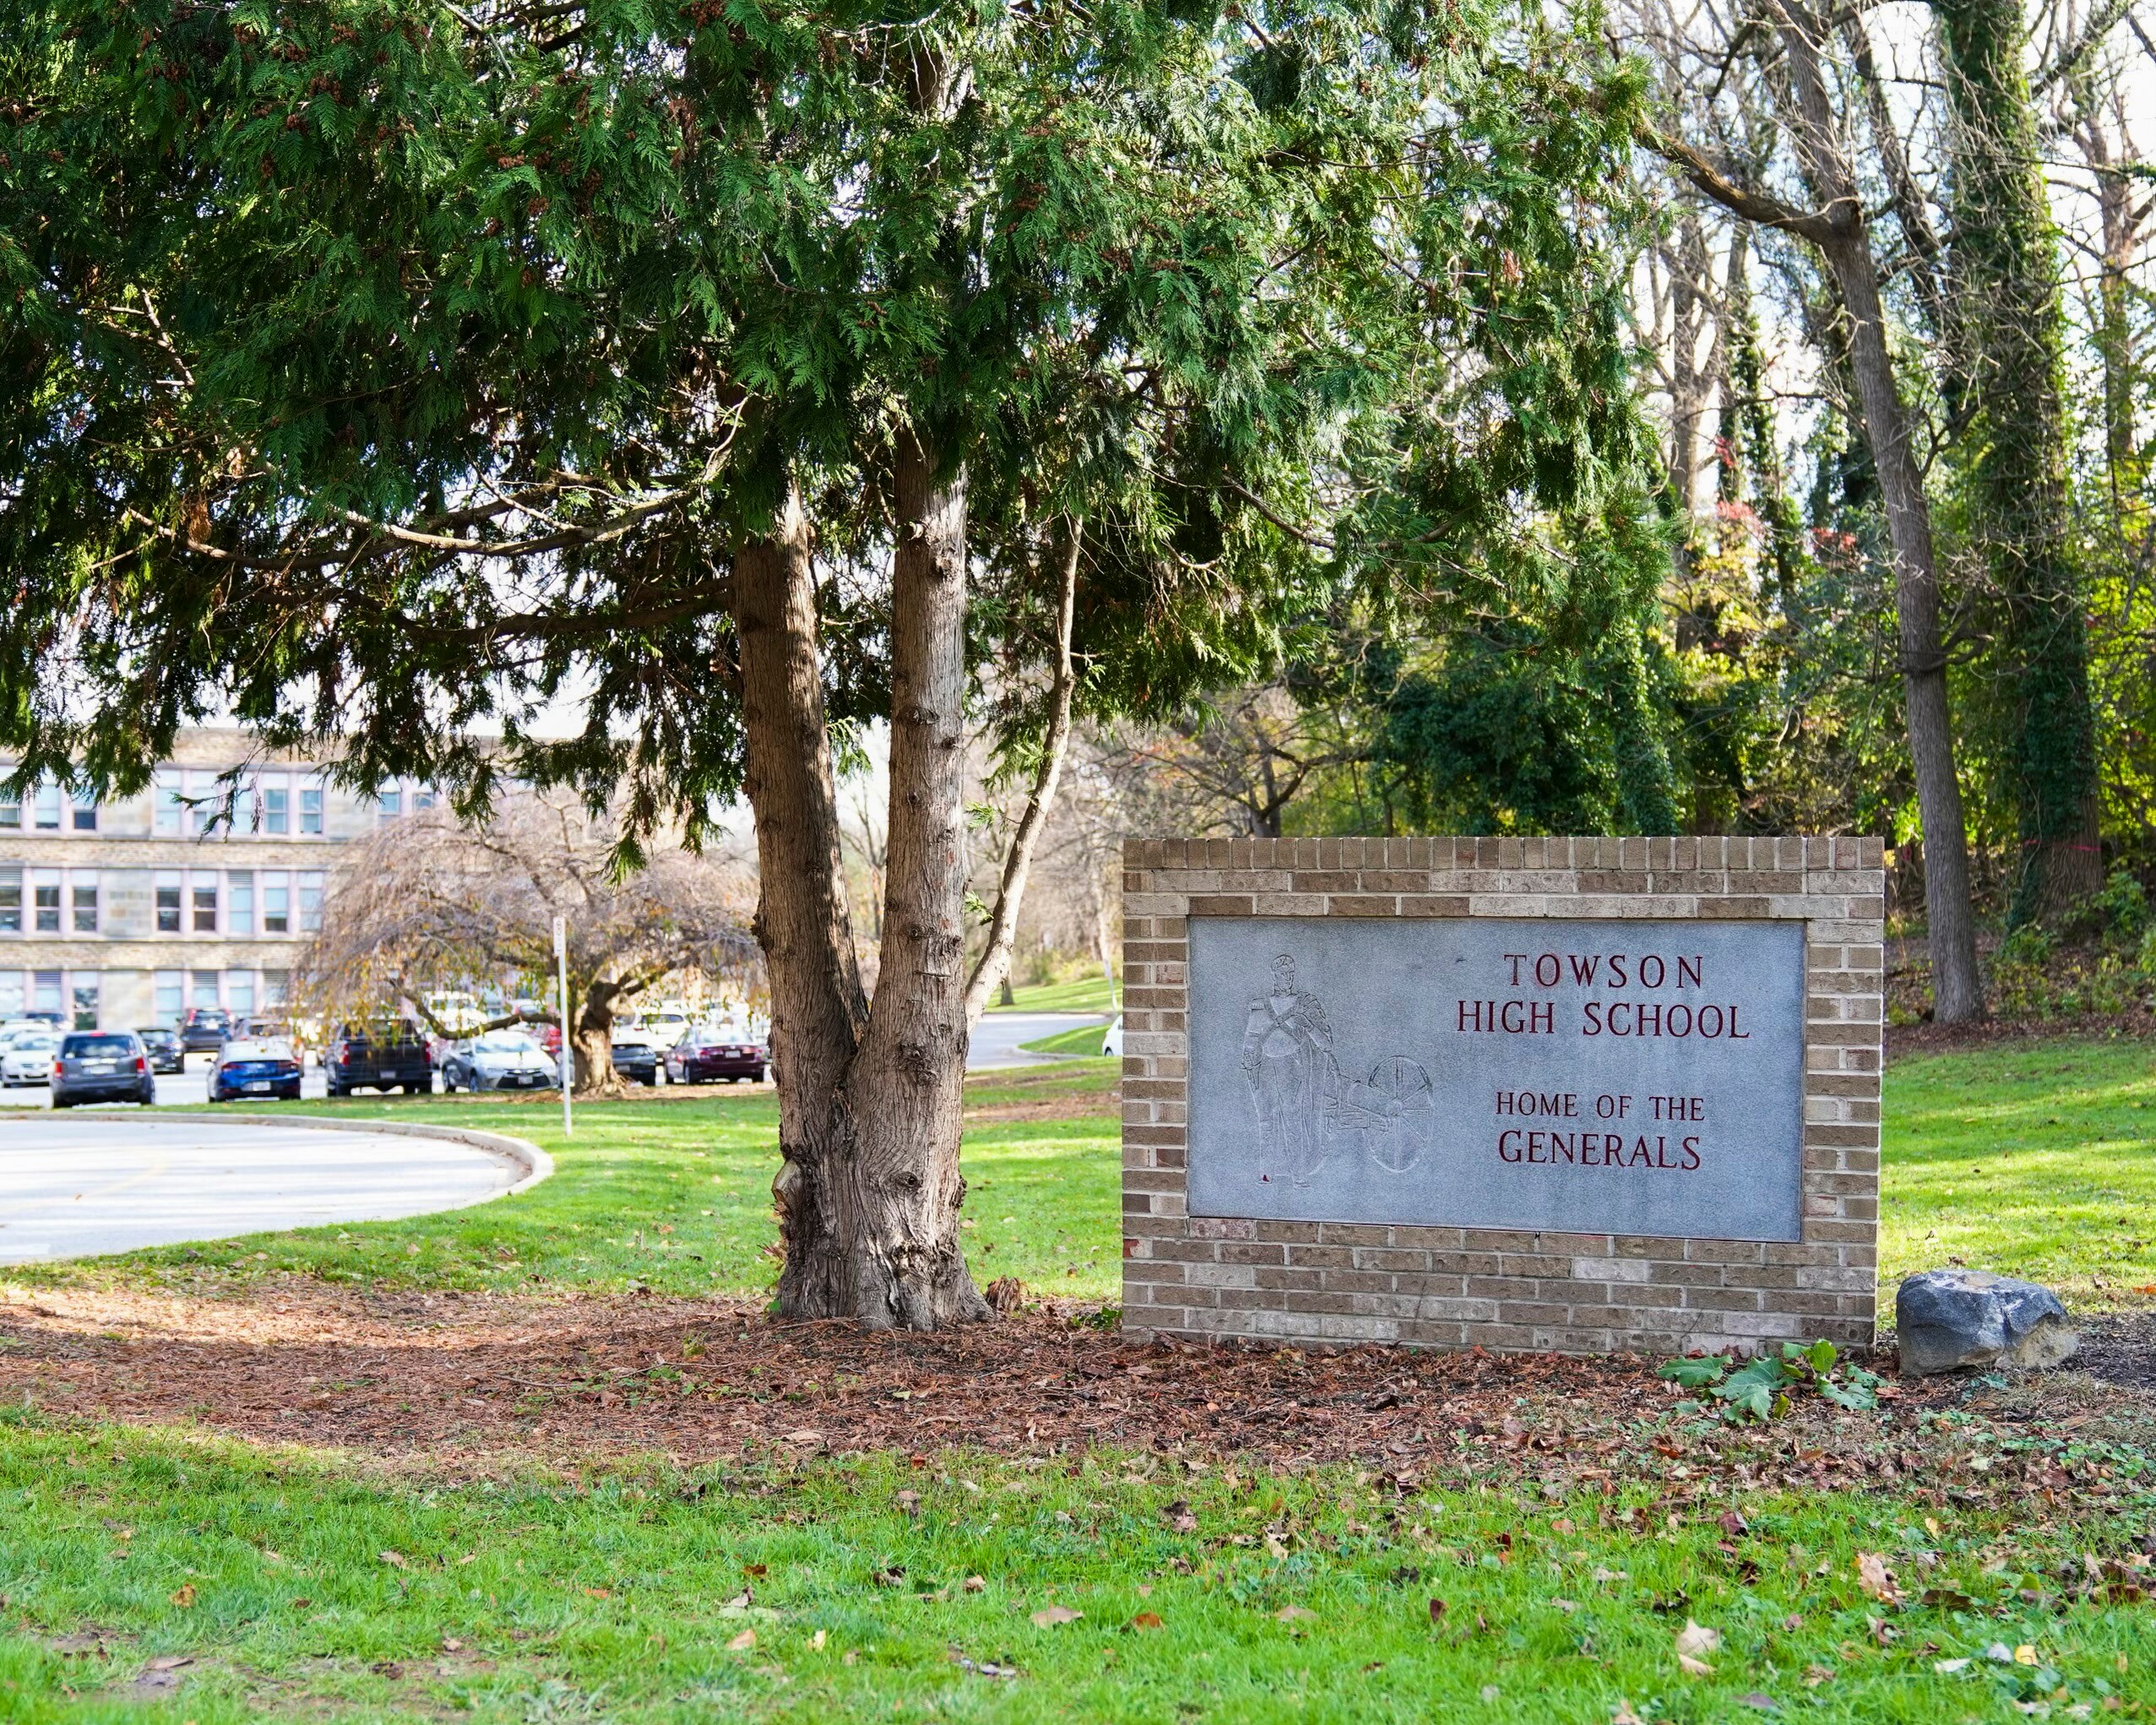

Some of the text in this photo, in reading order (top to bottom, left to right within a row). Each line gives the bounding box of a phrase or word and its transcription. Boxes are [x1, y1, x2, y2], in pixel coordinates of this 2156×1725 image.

[1502, 953, 1703, 989] TOWSON
[1457, 1000, 1750, 1039] HIGH SCHOOL
[1496, 1091, 1706, 1121] HOME OF THE
[1498, 1129, 1702, 1170] GENERALS
